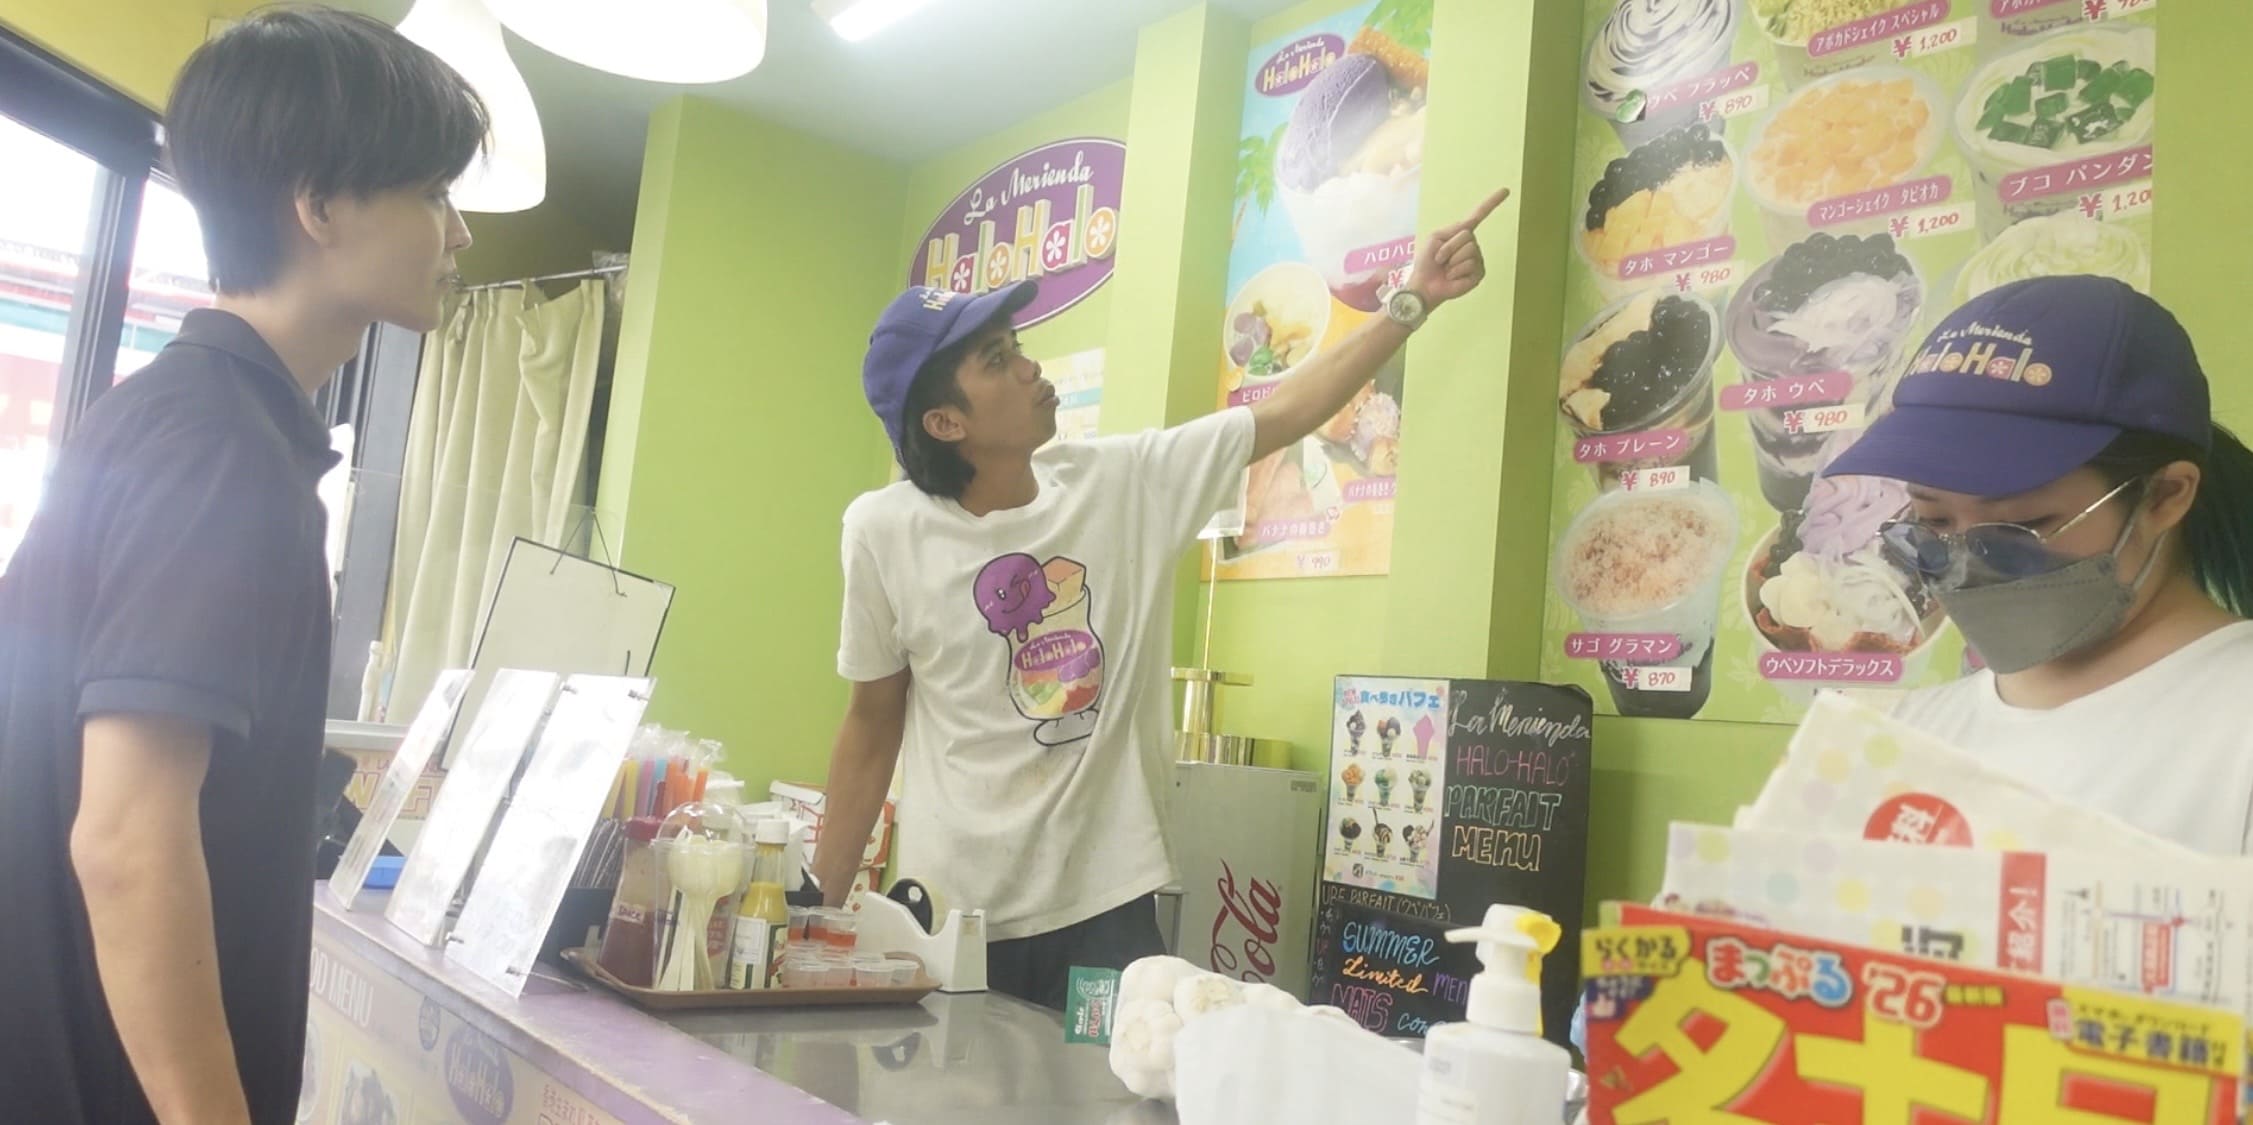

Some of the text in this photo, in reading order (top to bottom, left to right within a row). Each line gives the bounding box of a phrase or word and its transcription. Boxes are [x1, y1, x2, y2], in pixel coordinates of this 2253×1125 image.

[1891, 3, 1940, 29] スペシャル
[1687, 66, 1750, 98] フラッペ
[1725, 95, 1753, 114] 890
[964, 151, 1094, 225] La Merienda
[2010, 175, 2050, 197] ブコ
[1818, 183, 1940, 222] マンゴーシェイク タピオカ
[2112, 190, 2152, 213] 1,20
[924, 184, 1118, 295] HaloHalo
[1625, 246, 1729, 275] タホ マンゴー
[1701, 268, 1731, 285] 980
[1904, 341, 2053, 386] HaloHalo
[1743, 379, 1825, 404] タホ ウベ
[1814, 410, 1848, 427] 980
[1579, 435, 1680, 458] タホ プレーン
[1649, 471, 1676, 486] 890
[1021, 641, 1087, 669] HaloHalo
[1570, 637, 1673, 655] サゴ グラマン
[1647, 671, 1676, 687] 870
[1766, 657, 1895, 678] ウベソフトデラックス
[1448, 689, 1591, 747] La Merienda
[1456, 744, 1571, 787] HALO-HALO
[1444, 785, 1562, 831] PARFAIT
[1452, 825, 1542, 871] MENU
[1351, 890, 1396, 911] PARFAIT
[1342, 921, 1440, 968] SUMMER
[1342, 955, 1468, 1006] Limited MEN
[1709, 938, 1850, 1005] まっぷる
[328, 958, 375, 1028] MENU
